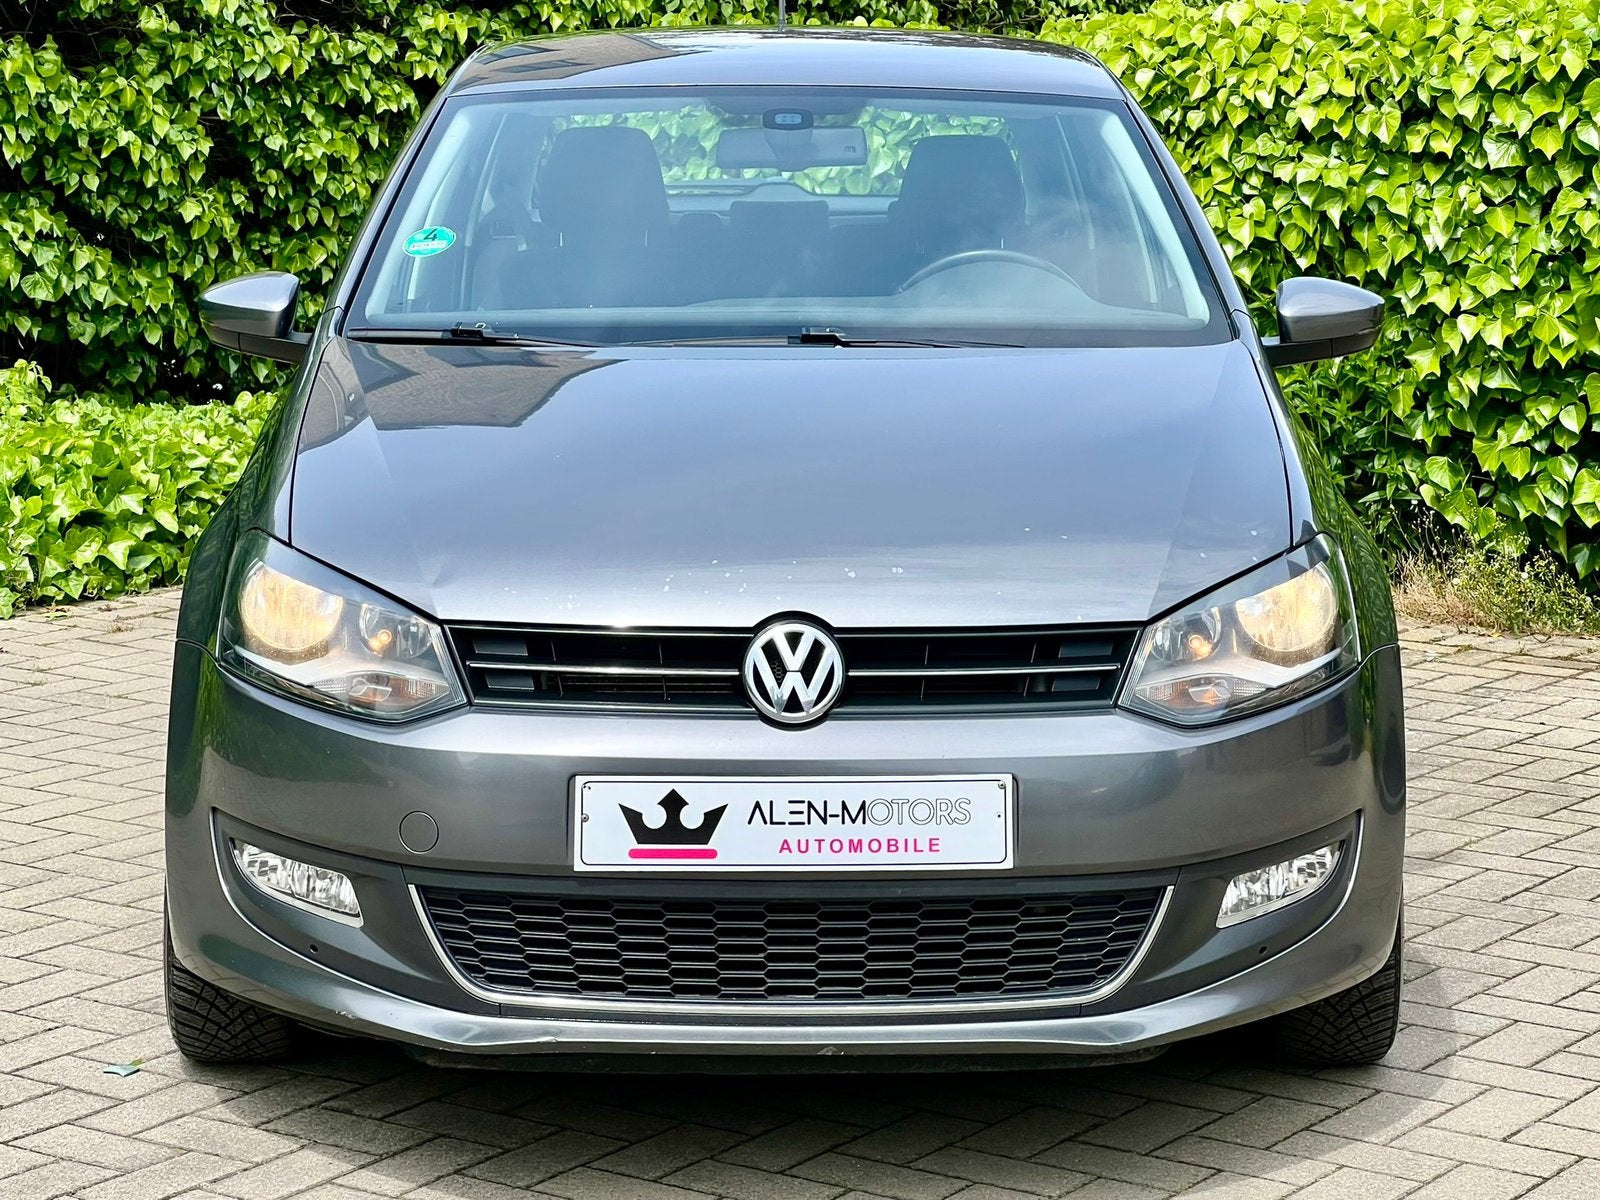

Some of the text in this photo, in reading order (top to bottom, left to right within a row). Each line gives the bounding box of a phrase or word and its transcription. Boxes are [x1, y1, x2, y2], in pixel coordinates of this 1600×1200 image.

[423, 228, 438, 241] 4
[747, 797, 971, 826] ALEN-MOTORS
[778, 837, 941, 854] AUTOMOBILE
